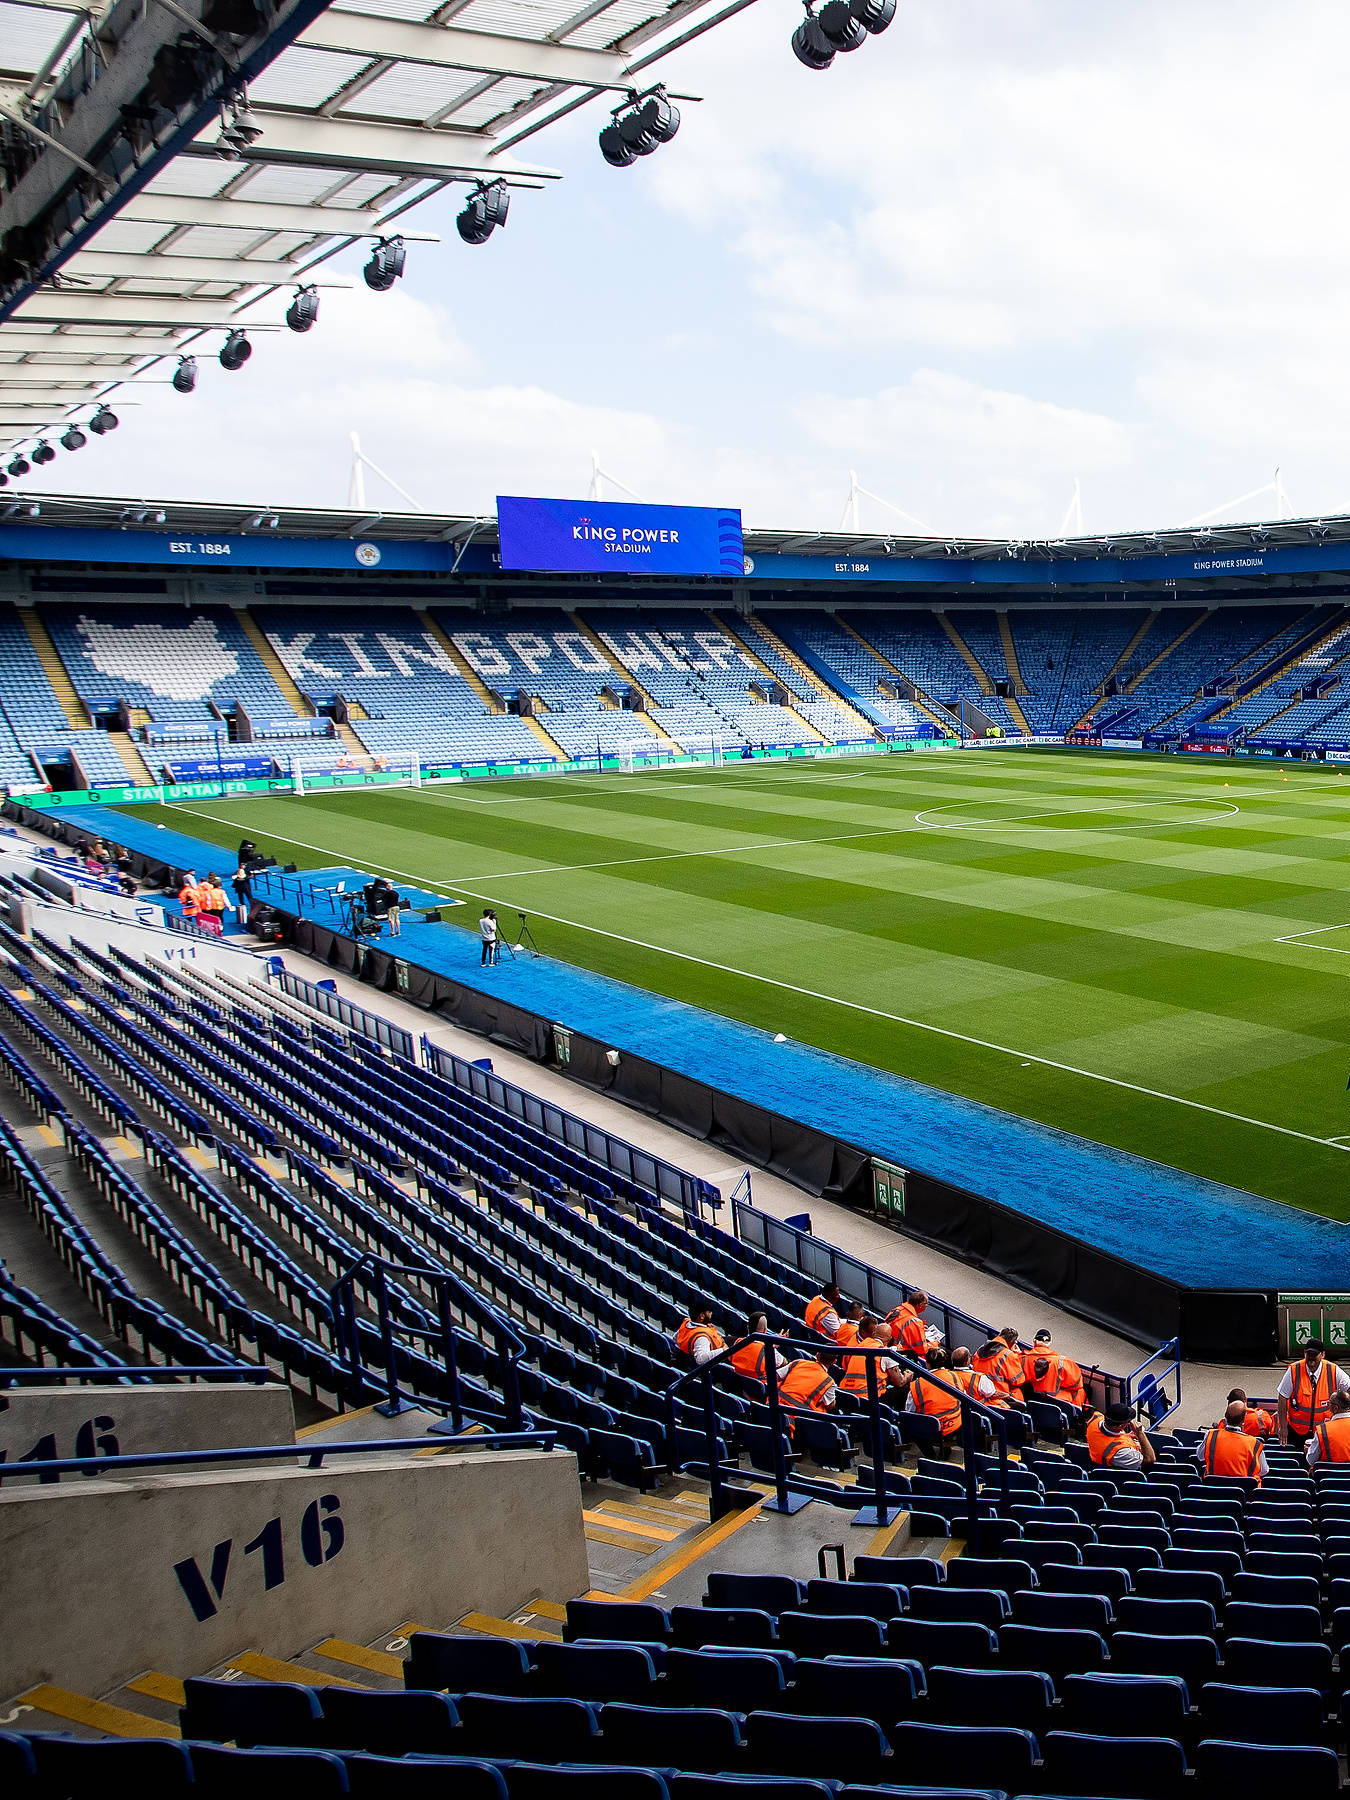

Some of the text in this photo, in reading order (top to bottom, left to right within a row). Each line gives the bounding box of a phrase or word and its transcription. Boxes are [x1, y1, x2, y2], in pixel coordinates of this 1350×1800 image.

[572, 526, 679, 543] KING POWER
[170, 542, 231, 555] EST. 1884
[604, 543, 651, 554] STADIUM
[834, 563, 870, 573] EST. 1884
[1193, 558, 1263, 570] KING POWER STADIUM
[804, 747, 827, 755] STAY
[830, 744, 875, 754] UNTAMED
[514, 766, 542, 775] STAY
[123, 788, 162, 800] STAY
[164, 947, 195, 960] V11
[173, 1494, 345, 1623] V16
